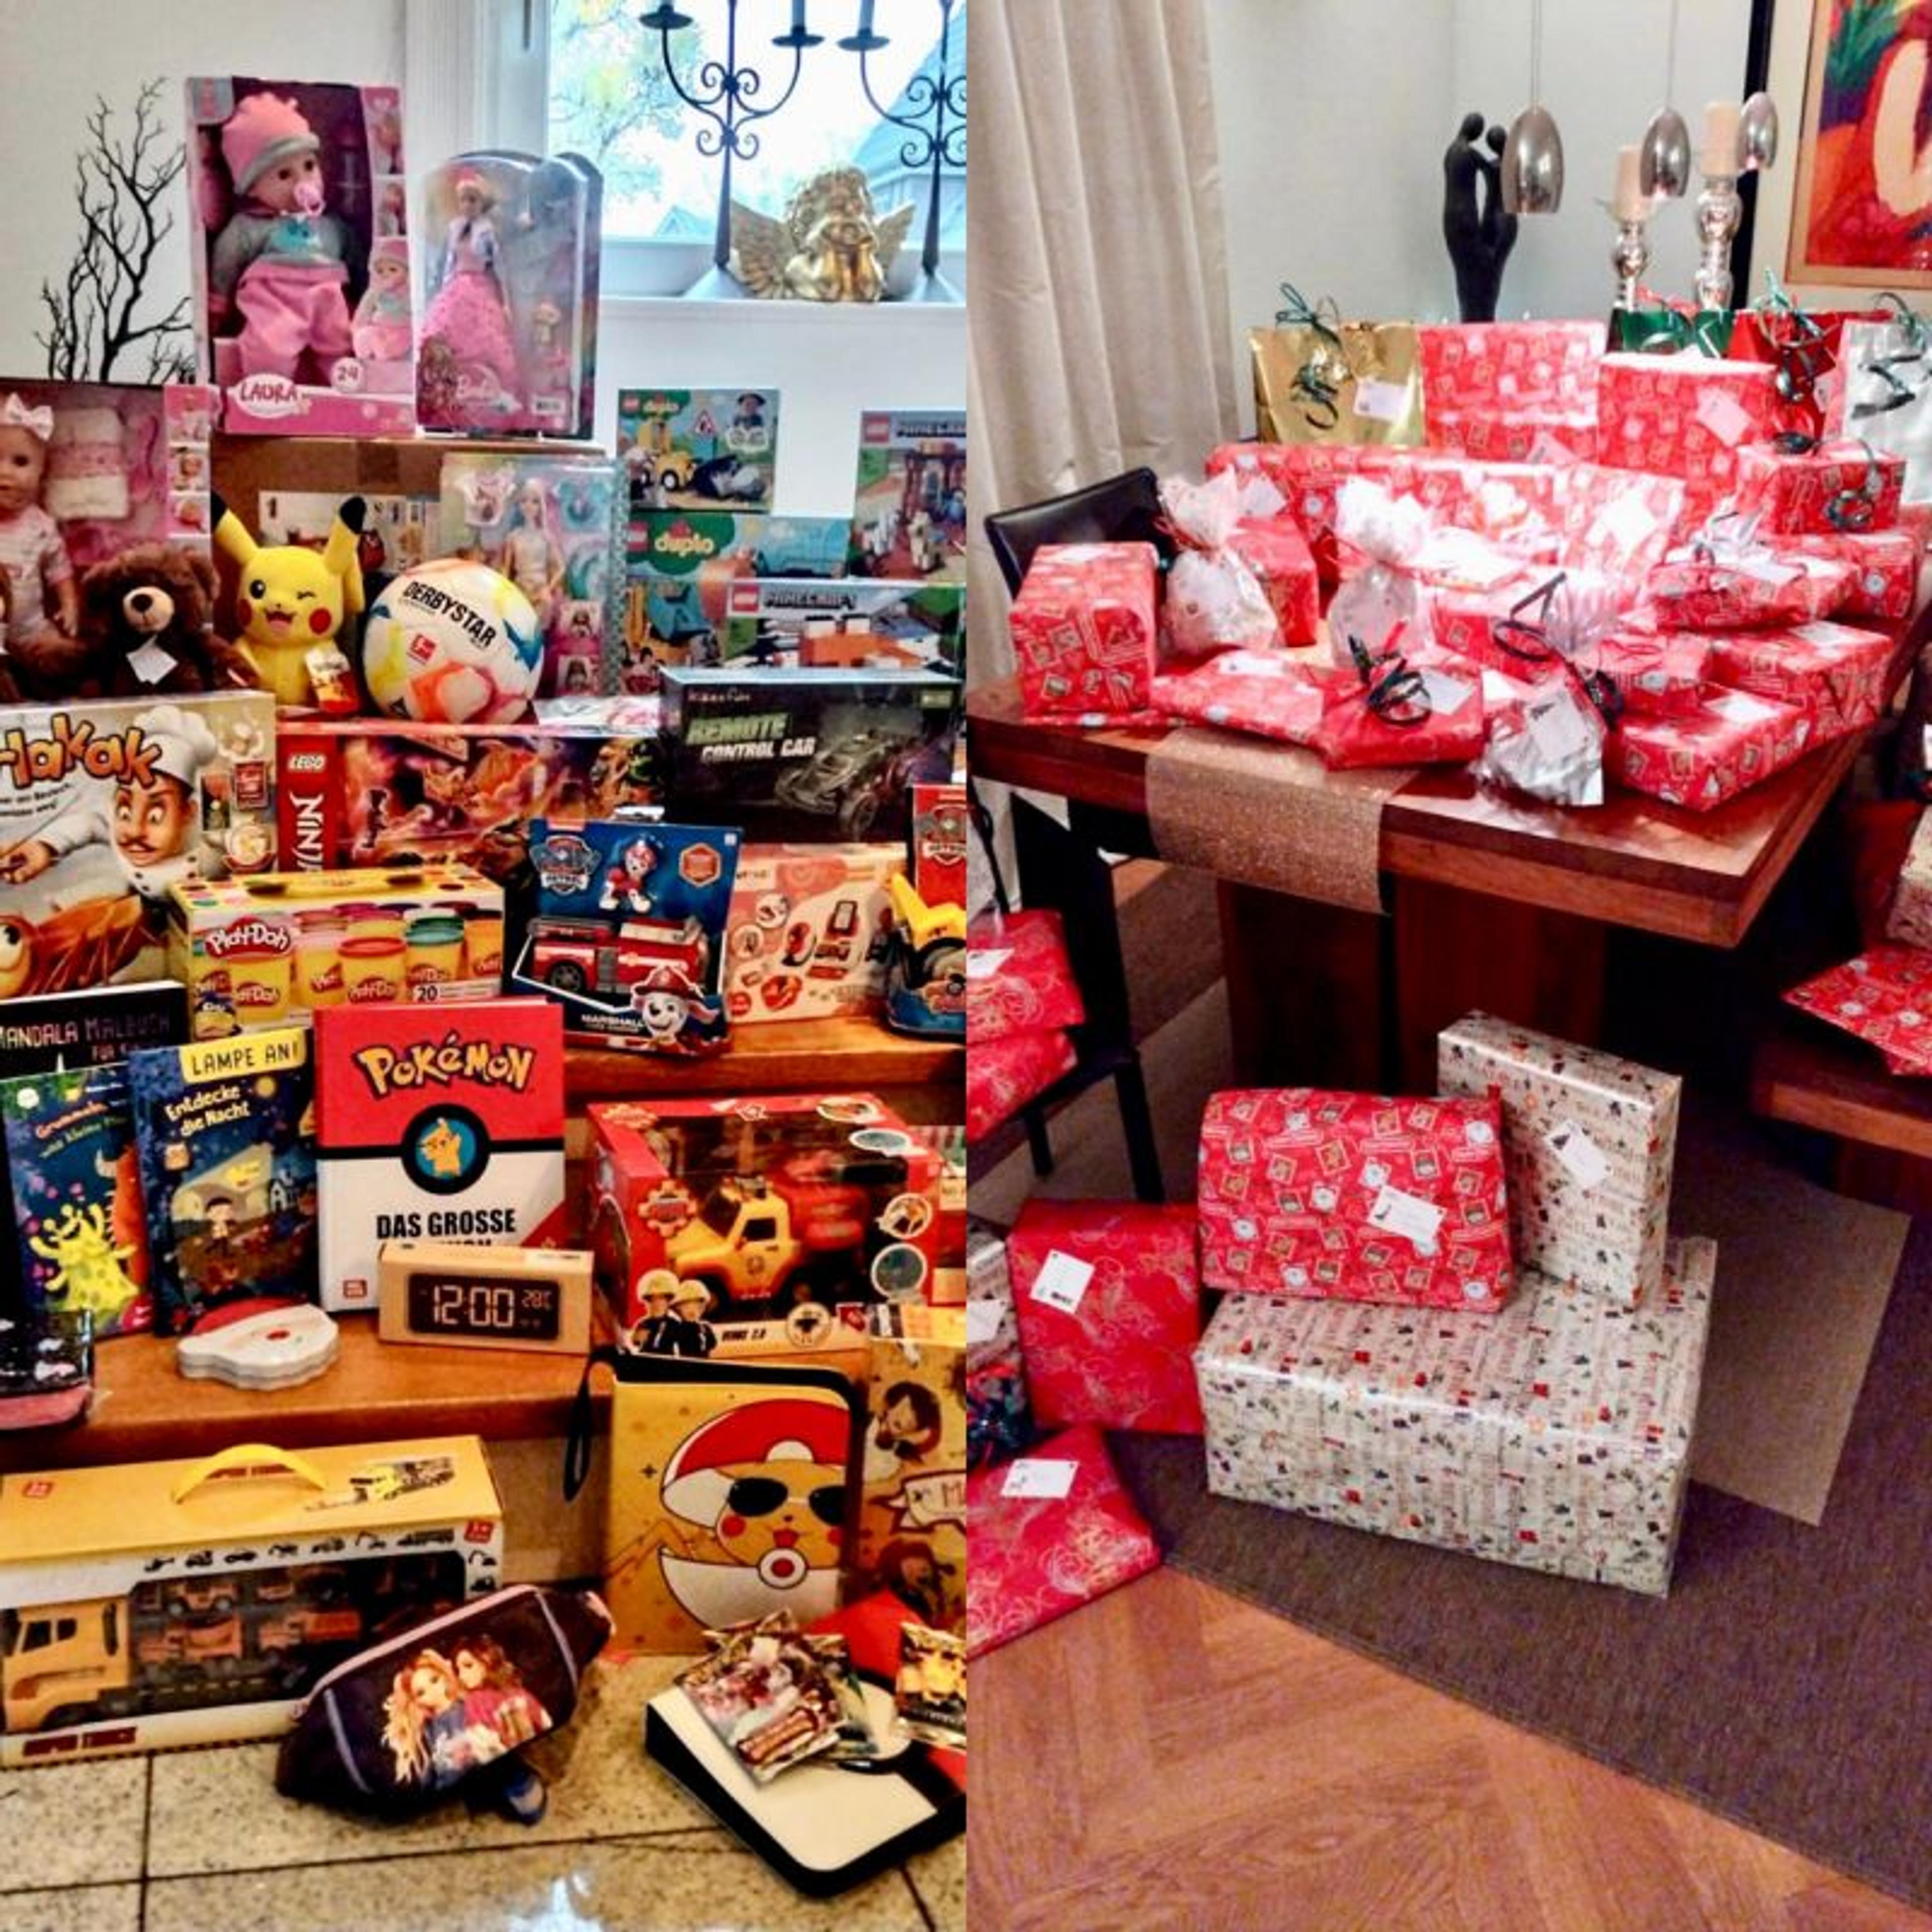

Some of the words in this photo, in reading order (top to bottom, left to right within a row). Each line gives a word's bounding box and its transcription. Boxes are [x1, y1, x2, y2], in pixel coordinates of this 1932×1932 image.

[240, 383, 298, 403] LAURA
[655, 531, 714, 558] duplo
[403, 581, 497, 648] DERBYSTAR
[685, 711, 790, 746] REMOTE
[287, 754, 326, 773] LEGO
[701, 742, 775, 764] CONTROL
[780, 736, 817, 758] CAR
[418, 984, 438, 1003] 20
[191, 1046, 256, 1076] LAMPE
[165, 1084, 240, 1121] Entdecke
[181, 1117, 206, 1137] die
[205, 1101, 251, 1126] Nacht
[376, 1212, 422, 1239] DAS
[427, 1209, 516, 1237] GROSSE
[433, 1284, 515, 1328] 12:00
